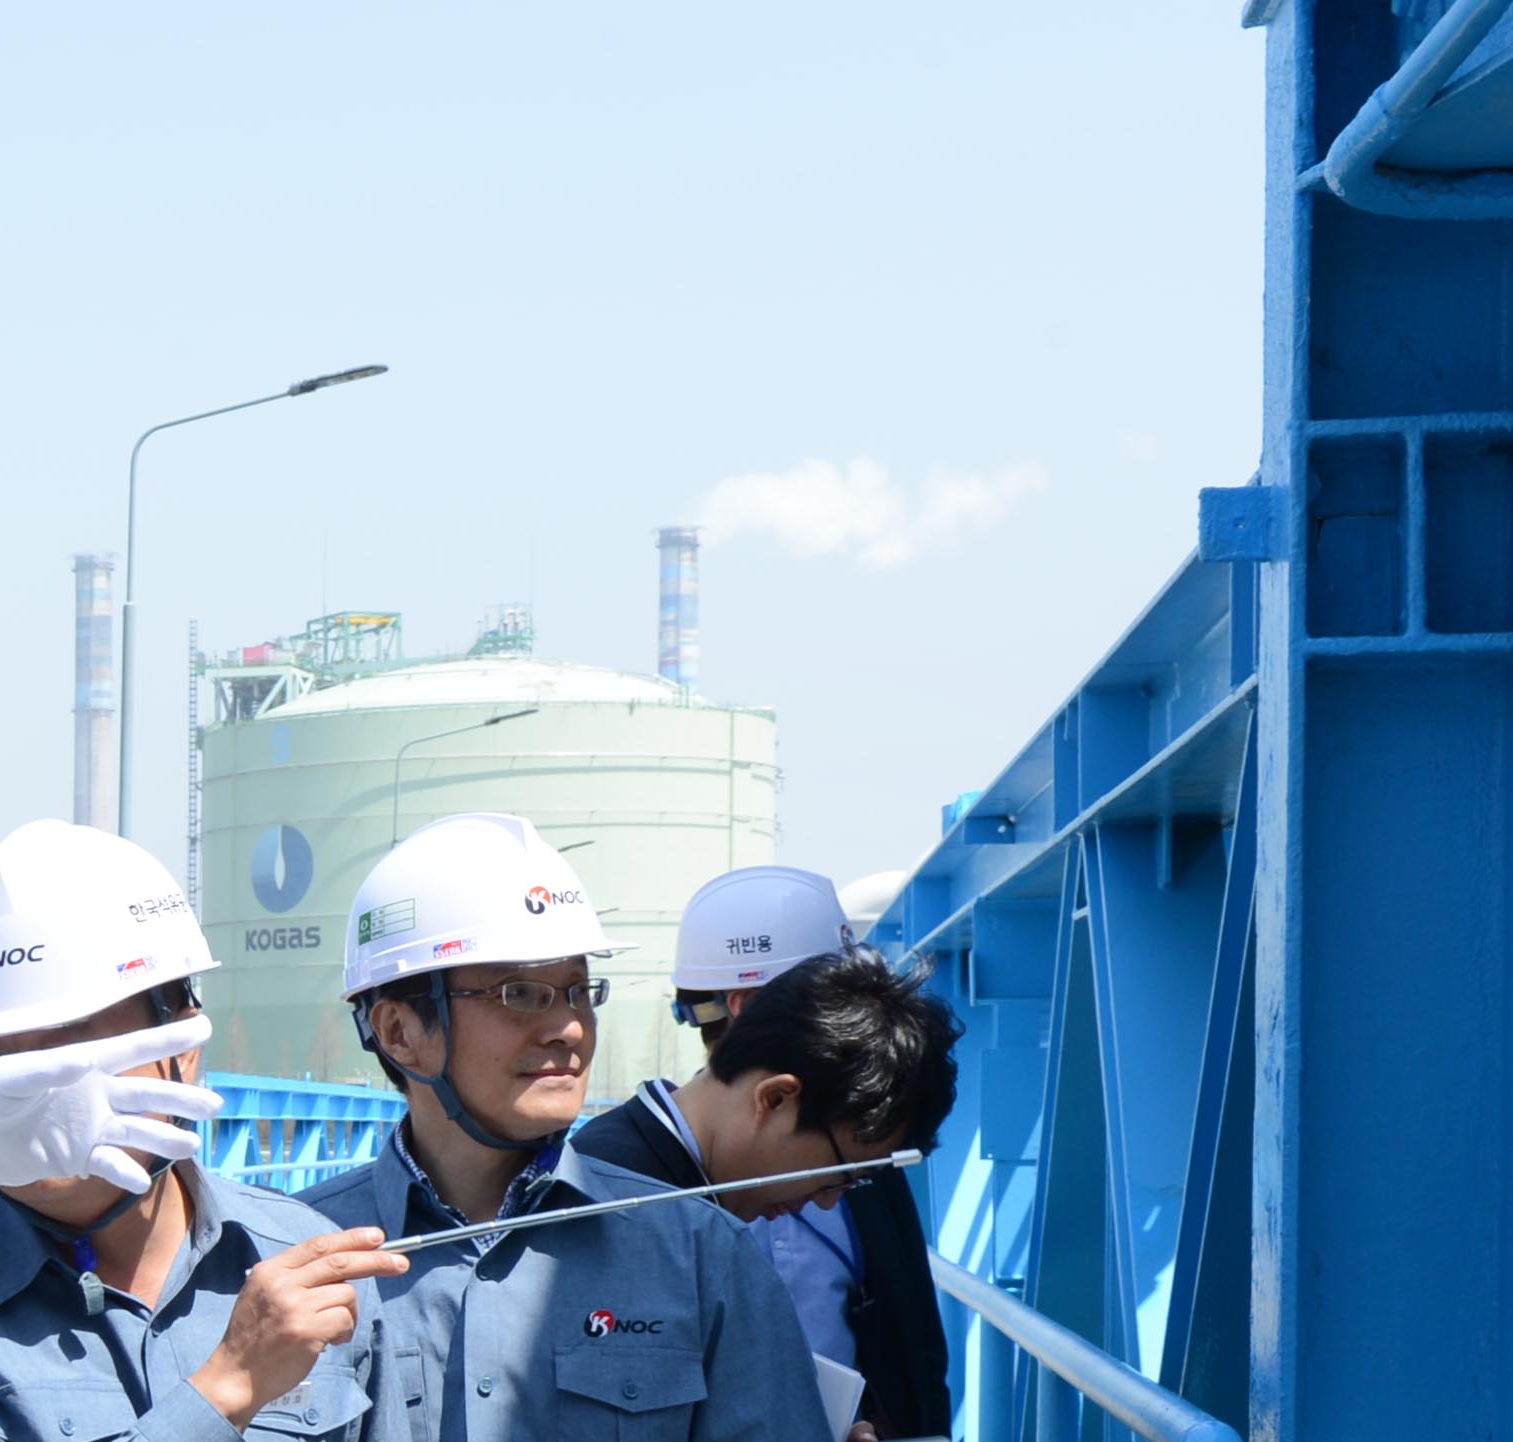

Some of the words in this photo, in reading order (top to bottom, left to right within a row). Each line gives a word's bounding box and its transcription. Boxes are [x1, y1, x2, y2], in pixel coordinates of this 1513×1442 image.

[271, 723, 292, 765] 9
[524, 886, 585, 915] KNOC
[726, 934, 772, 955] 귀빈용
[583, 1309, 665, 1338] KNOC
